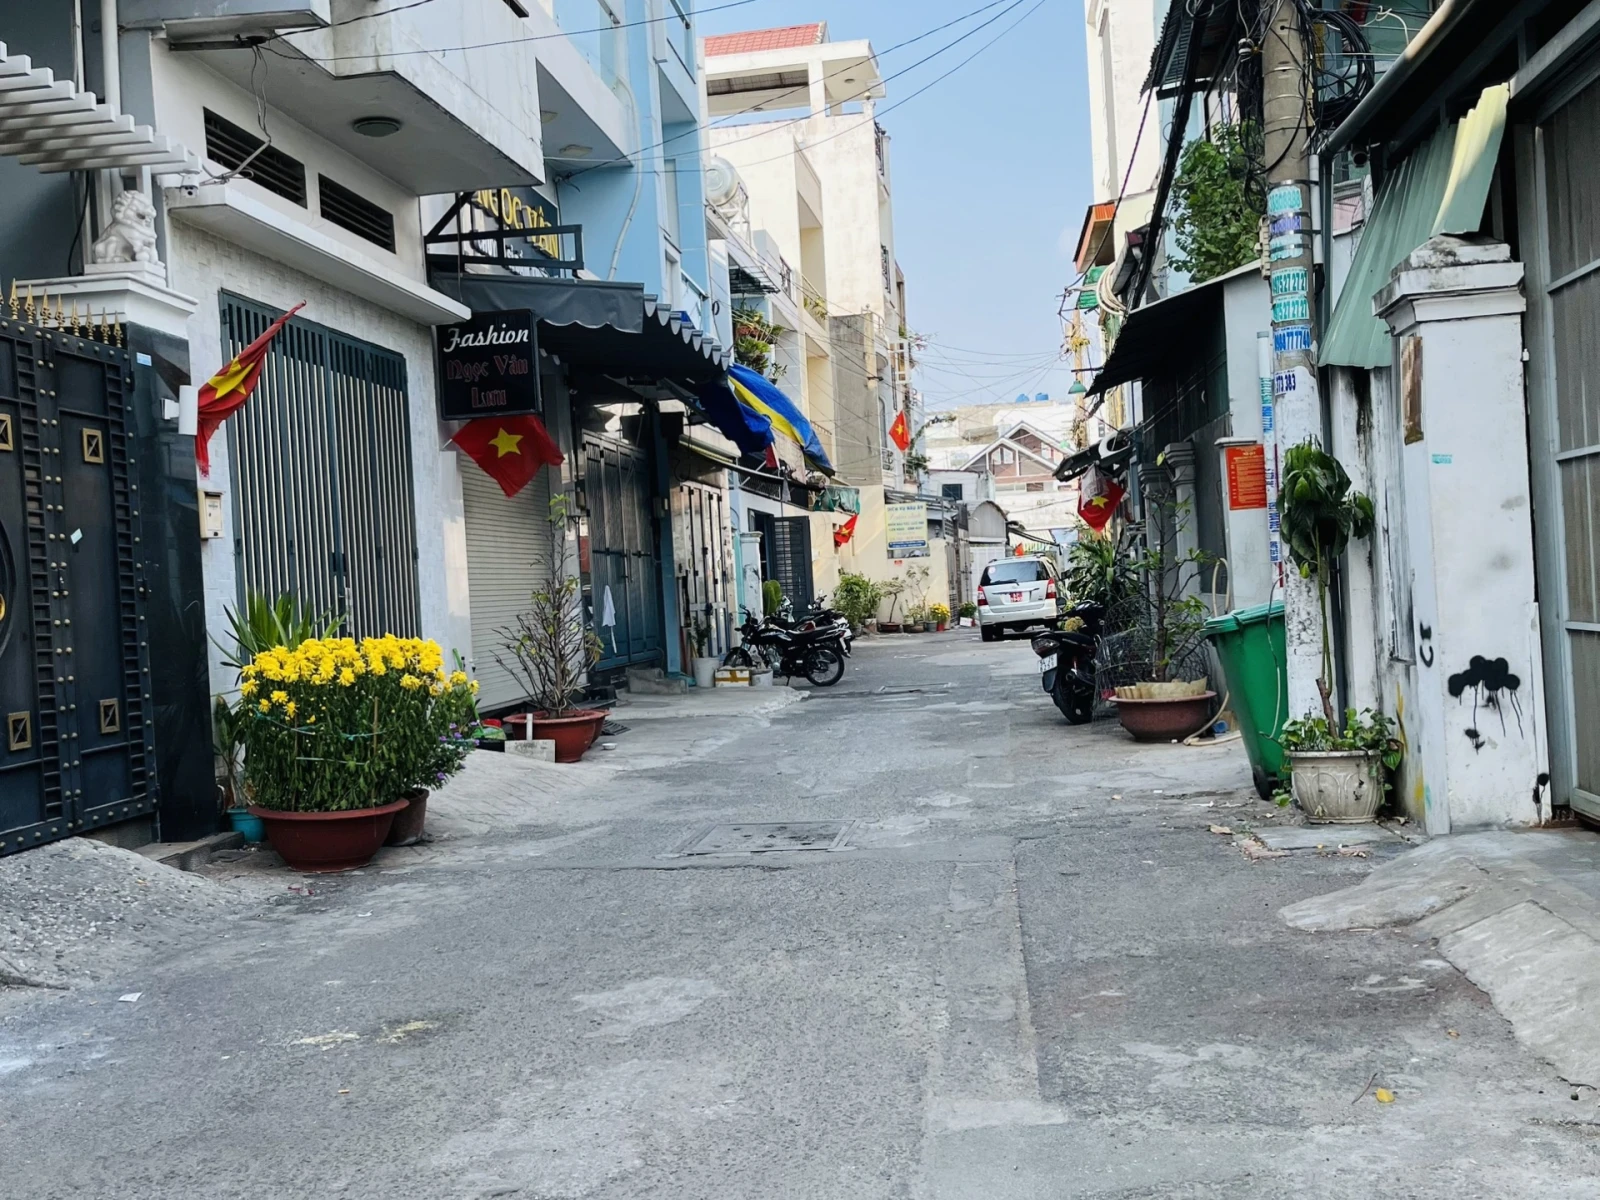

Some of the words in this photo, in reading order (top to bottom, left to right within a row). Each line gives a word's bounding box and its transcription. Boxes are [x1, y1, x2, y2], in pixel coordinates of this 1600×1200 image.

[443, 323, 529, 353] Fashion
[446, 359, 489, 382] Ngọc
[493, 354, 528, 375] Vân
